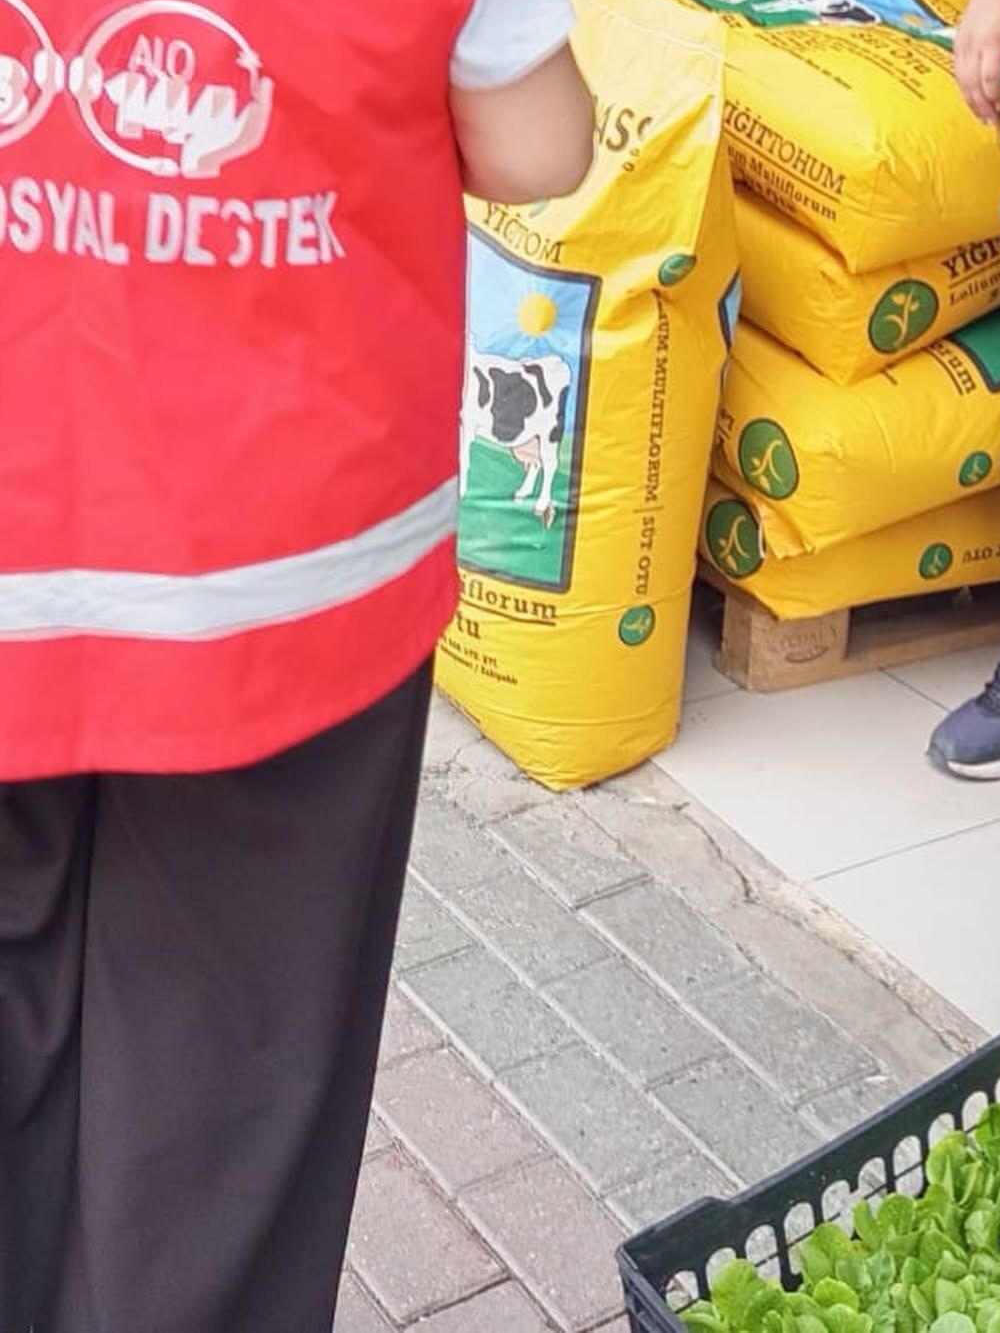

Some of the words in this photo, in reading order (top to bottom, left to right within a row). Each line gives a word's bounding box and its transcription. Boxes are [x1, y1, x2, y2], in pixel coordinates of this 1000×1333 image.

[724, 98, 847, 196] İĞİTTOHUM
[0, 176, 130, 265] SYAL
[144, 190, 347, 269] DESTEK
[456, 610, 481, 640] tu
